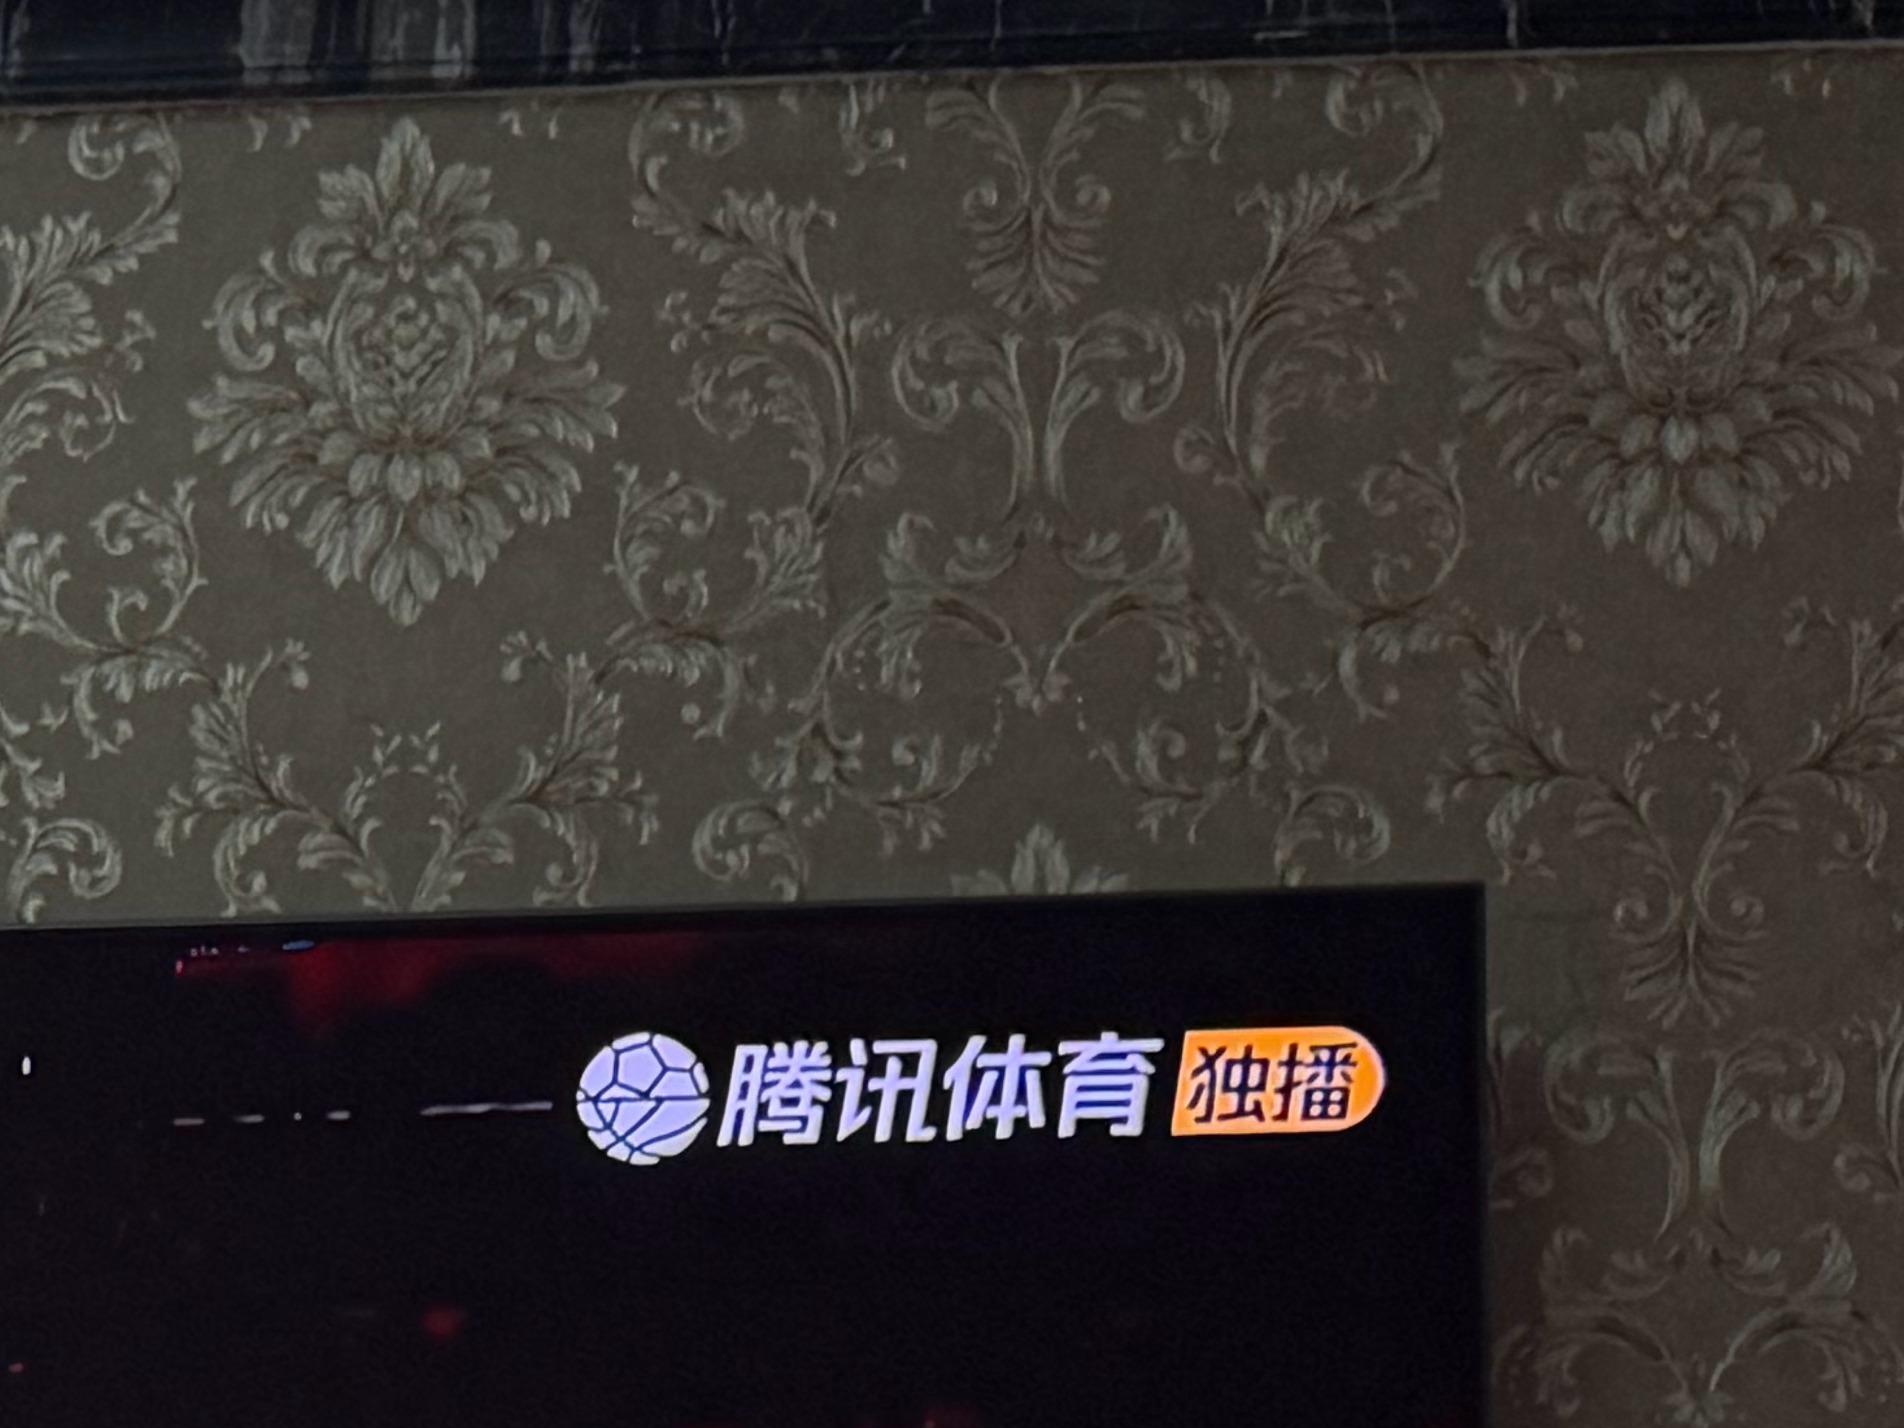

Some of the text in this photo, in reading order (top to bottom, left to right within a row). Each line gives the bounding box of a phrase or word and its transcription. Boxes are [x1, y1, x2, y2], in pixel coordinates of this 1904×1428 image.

[716, 1032, 1359, 1146] 腾讯体育 独播
